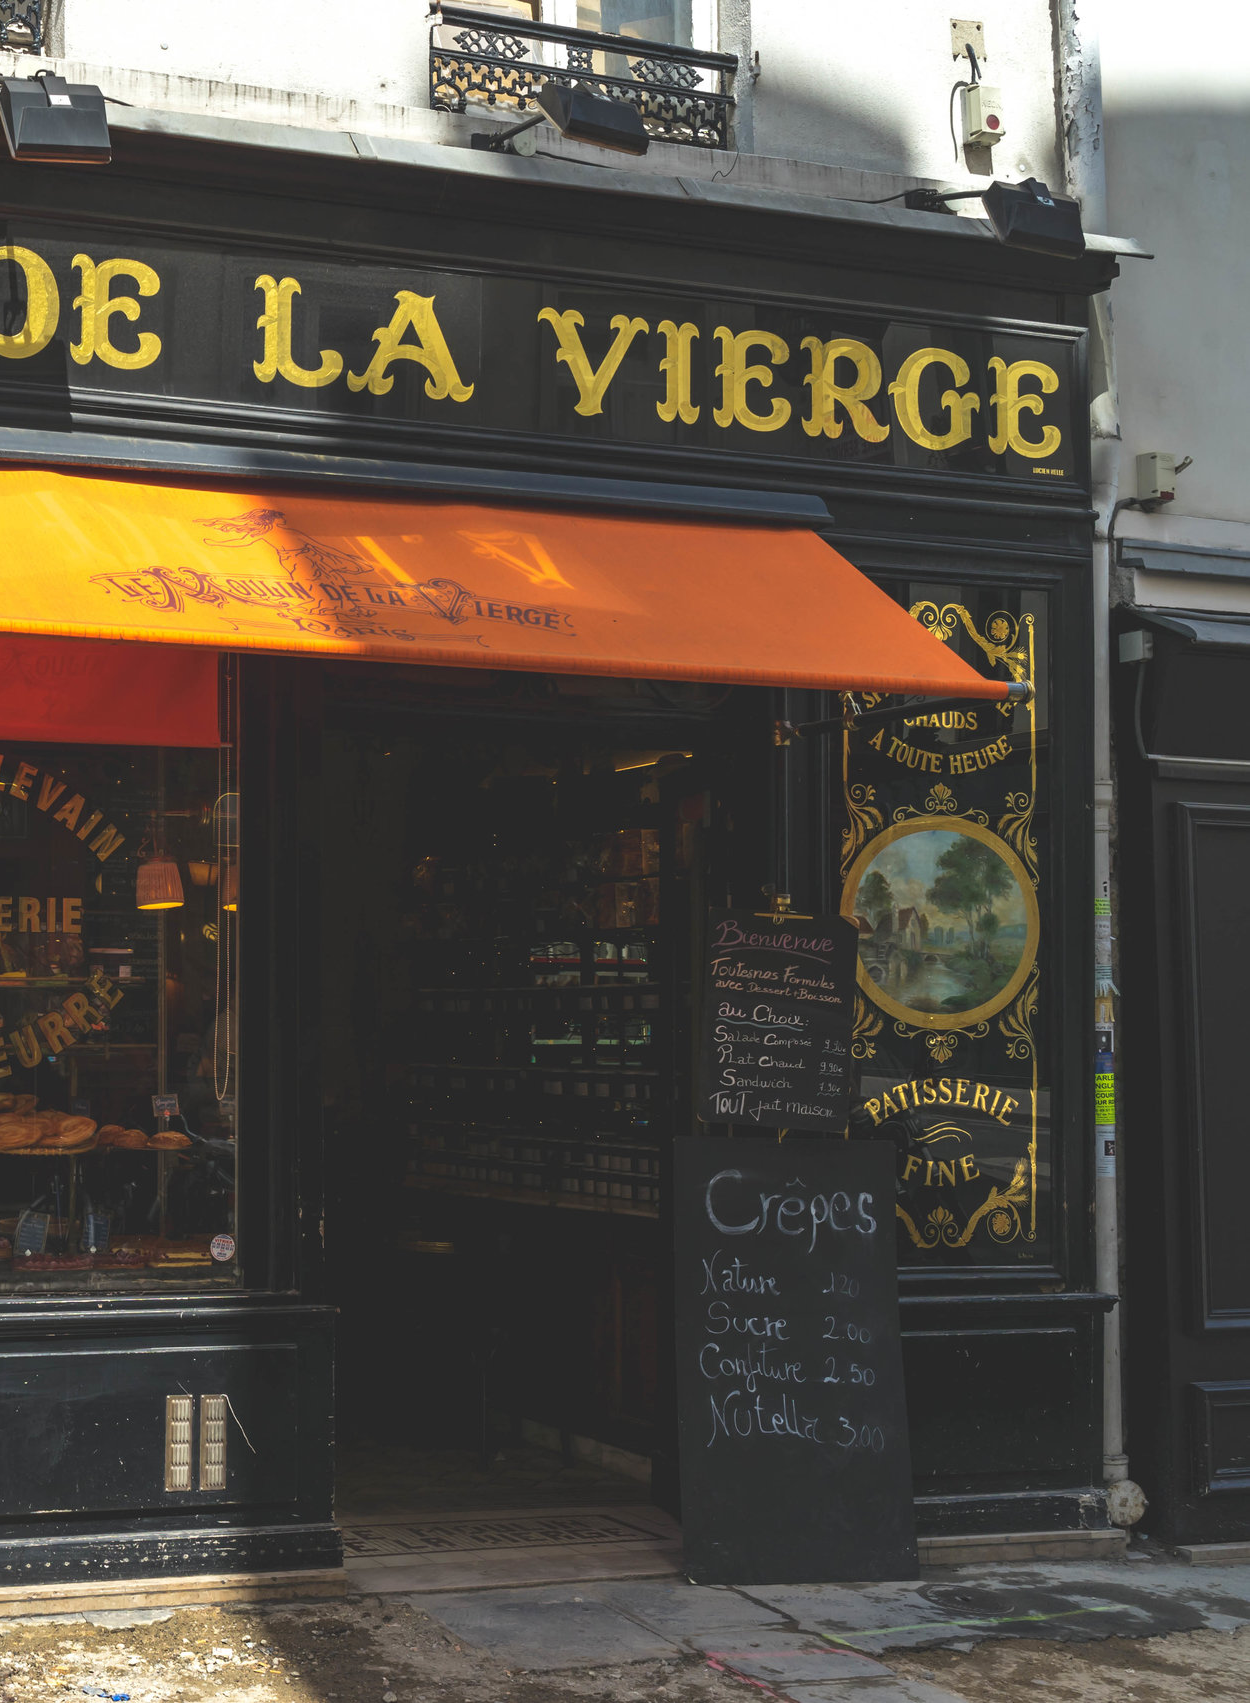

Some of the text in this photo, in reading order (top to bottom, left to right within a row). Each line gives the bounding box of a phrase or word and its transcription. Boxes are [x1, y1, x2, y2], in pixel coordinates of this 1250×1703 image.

[253, 274, 475, 403] LA
[538, 306, 1062, 459] VIERGE
[107, 577, 162, 598] LE
[320, 582, 361, 604] DE
[365, 588, 406, 606] LA
[396, 577, 560, 630] VIERGE
[868, 728, 1013, 775] A TOUTE HEURE
[715, 979, 744, 991] avec
[719, 1069, 793, 1089] Sandwich
[863, 1078, 1019, 1127] PATISSERIE
[901, 1153, 980, 1187] FINE
[706, 1169, 877, 1254] Crêpes
[700, 1249, 781, 1295] Nature
[705, 1301, 871, 1344] Sucre 2.00
[699, 1342, 875, 1392] Confiture 2.50
[707, 1390, 885, 1451] Nutella 3.00
